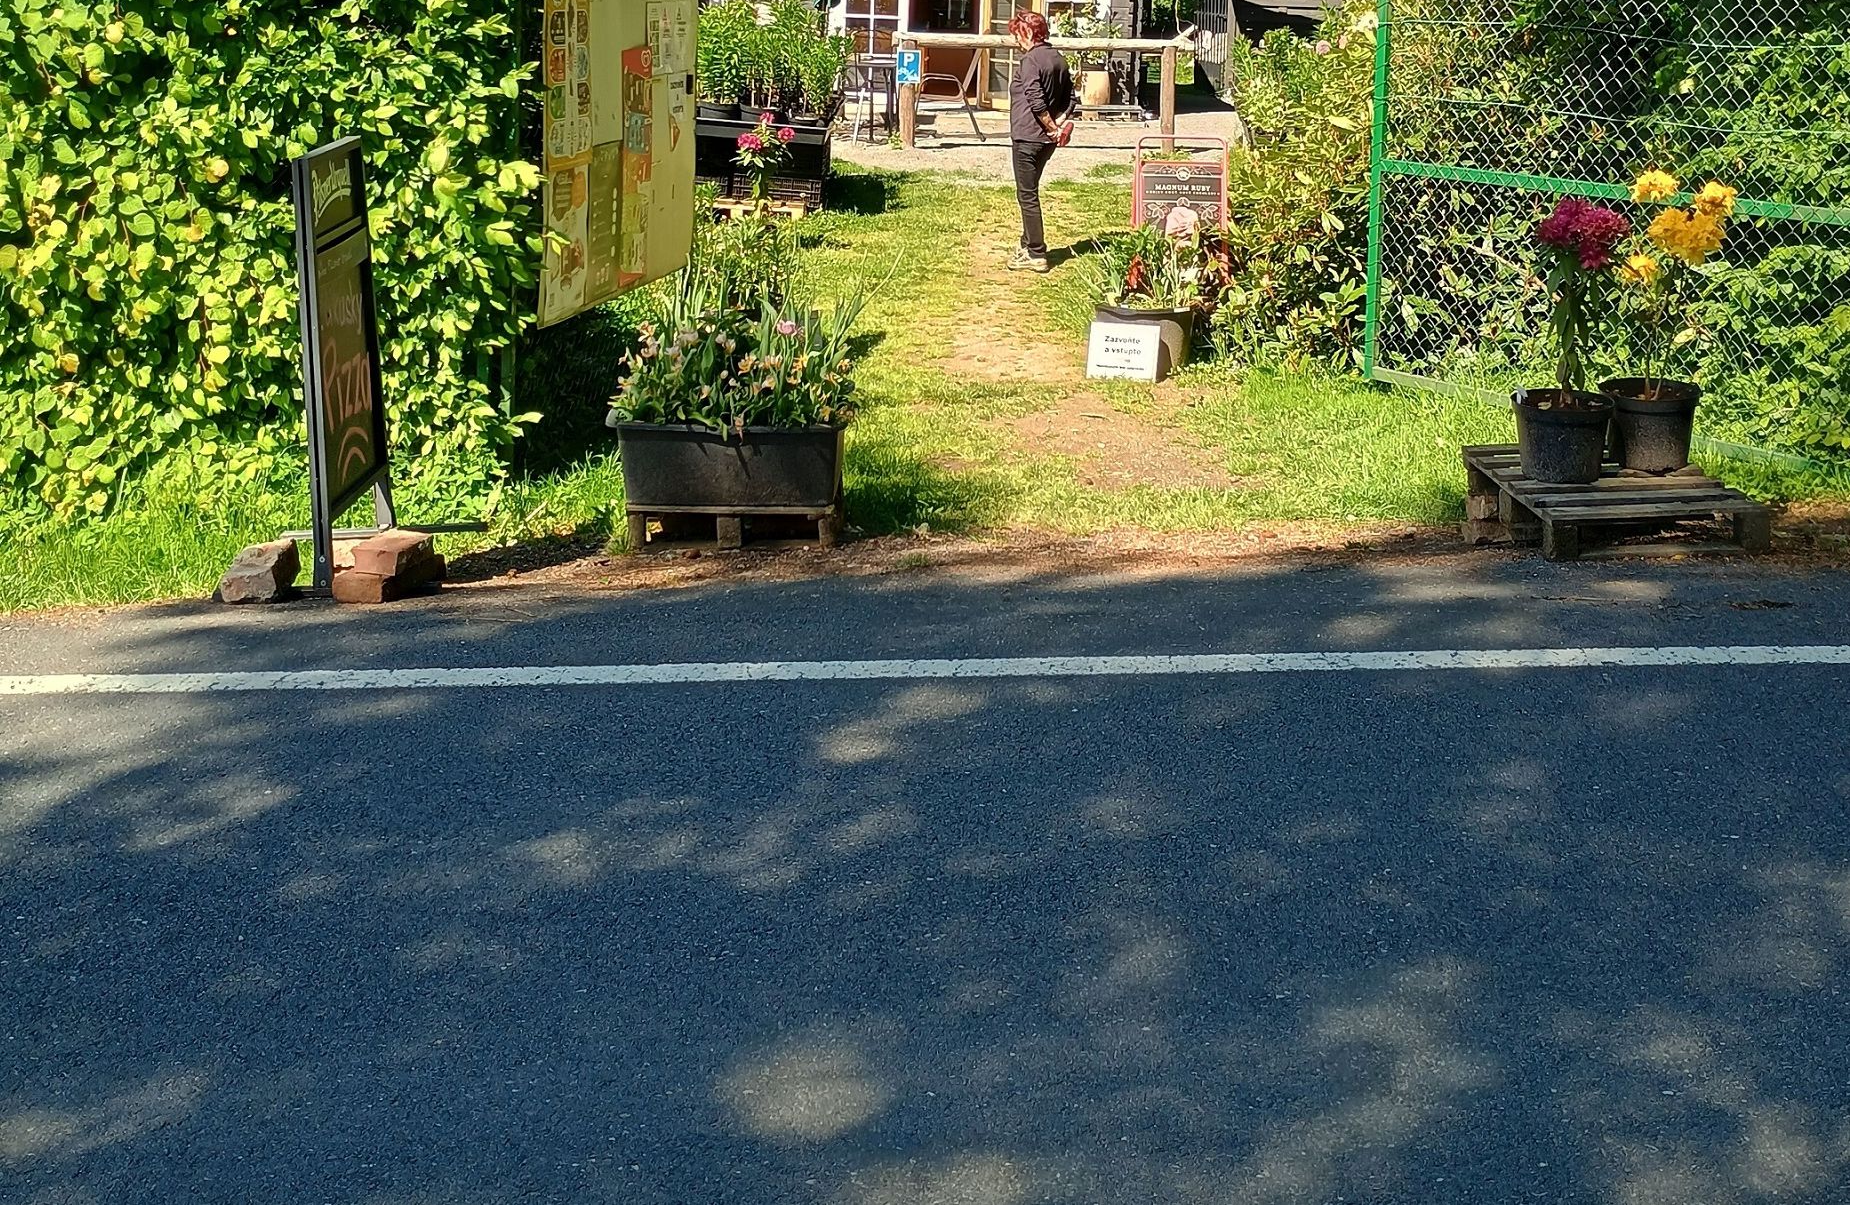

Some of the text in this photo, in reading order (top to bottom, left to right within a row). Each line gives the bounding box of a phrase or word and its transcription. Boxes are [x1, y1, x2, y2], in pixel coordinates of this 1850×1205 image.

[903, 52, 915, 67] P
[1154, 183, 1190, 192] MAGNUM
[323, 337, 373, 435] Pizza
